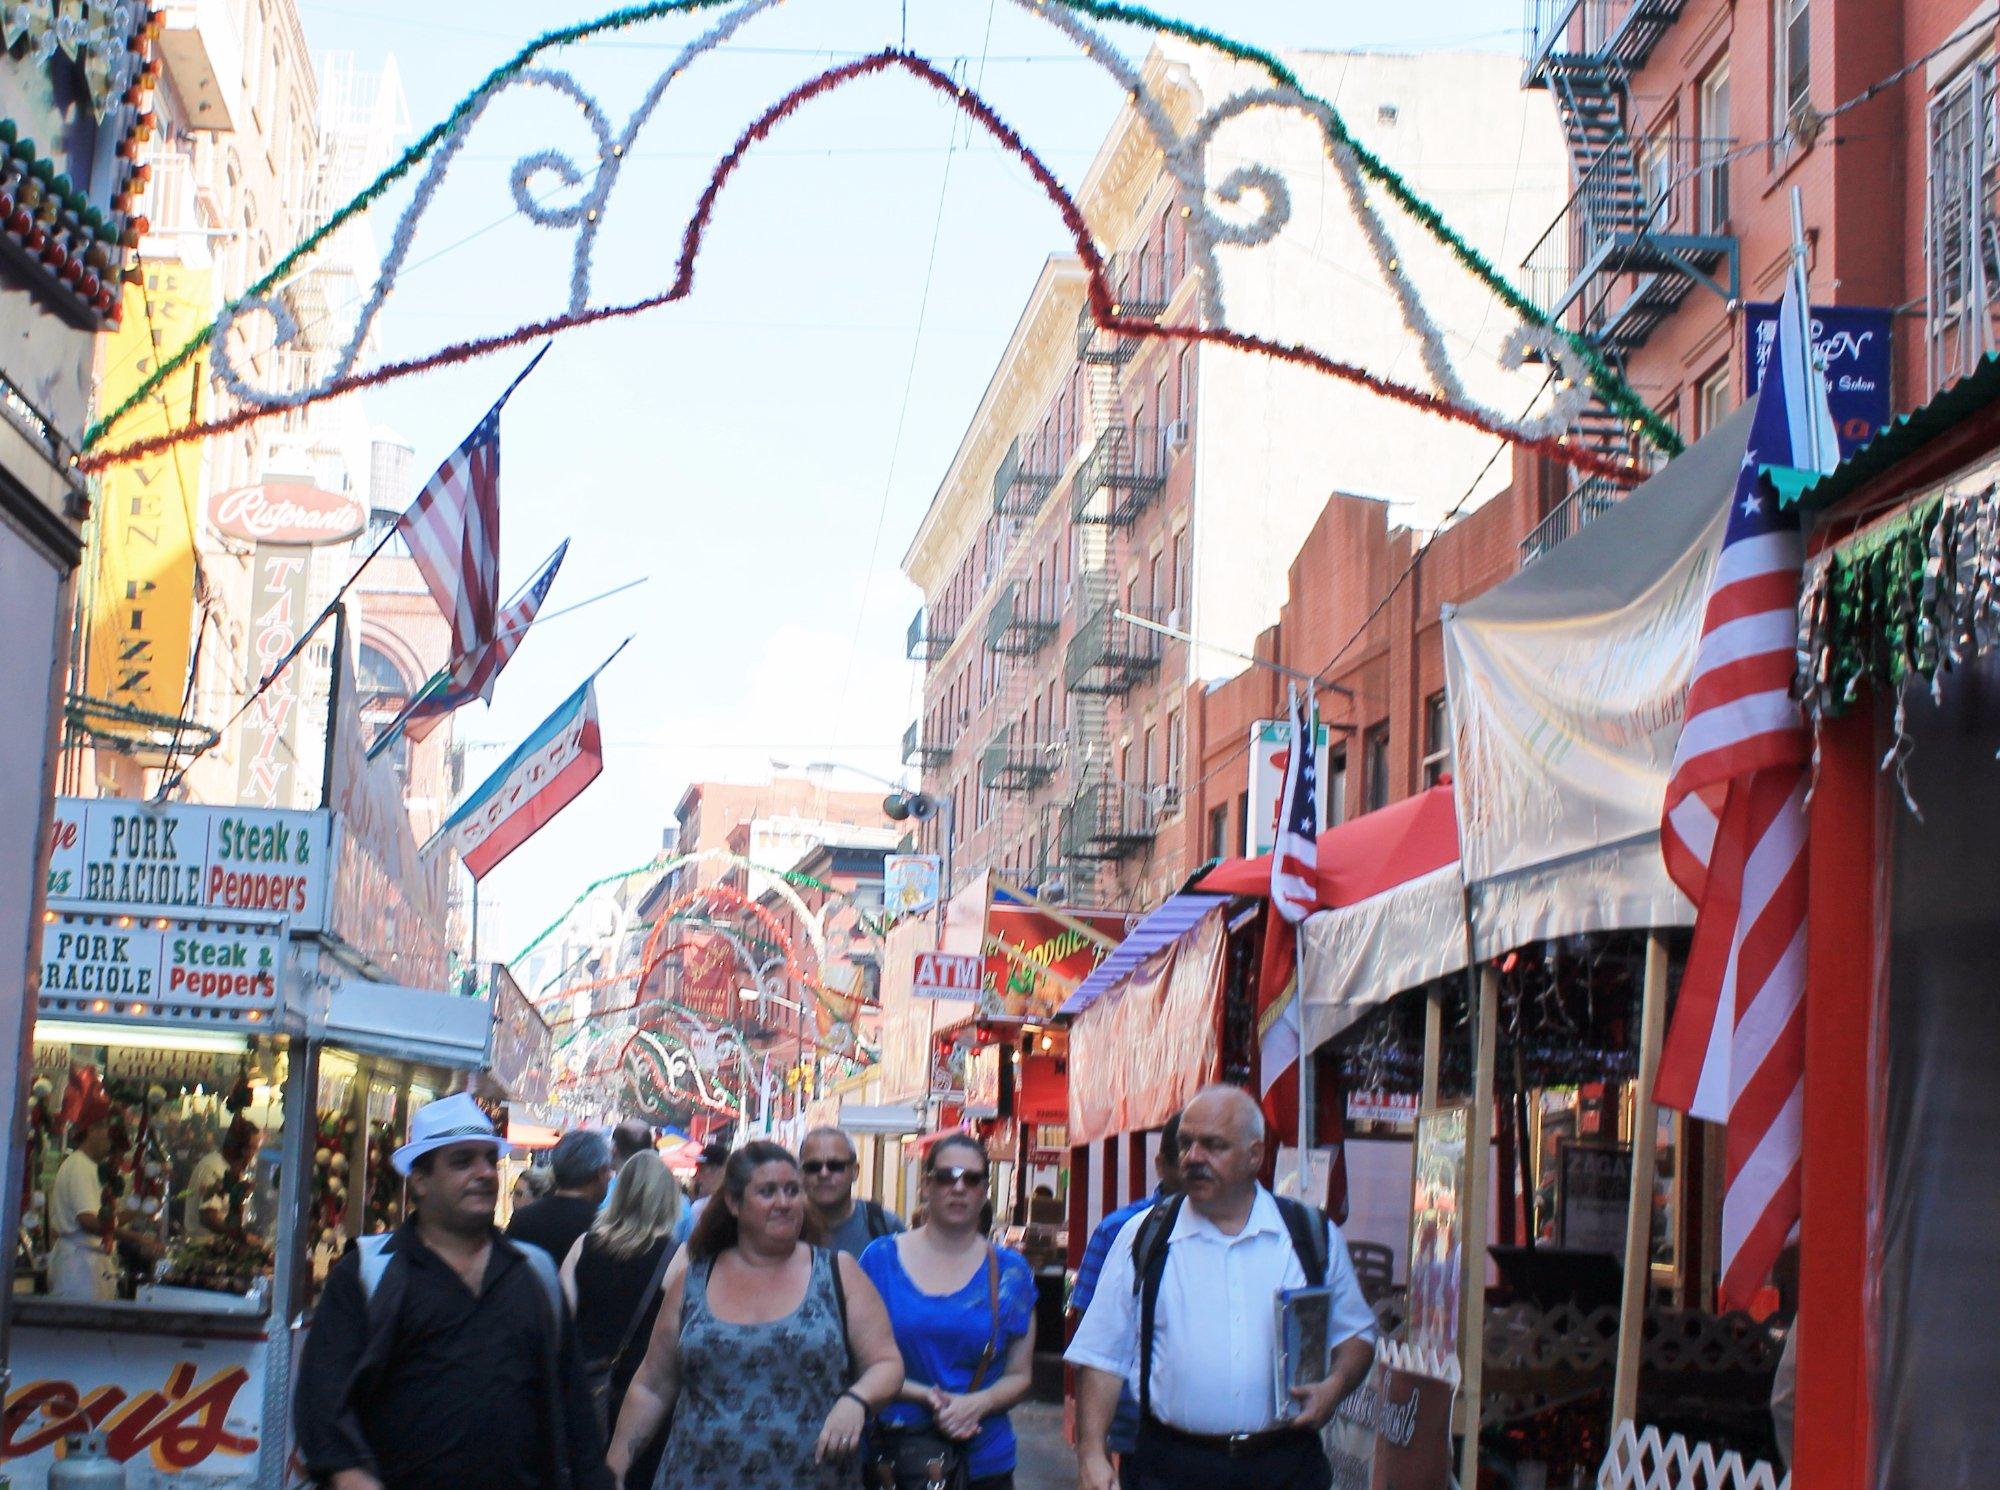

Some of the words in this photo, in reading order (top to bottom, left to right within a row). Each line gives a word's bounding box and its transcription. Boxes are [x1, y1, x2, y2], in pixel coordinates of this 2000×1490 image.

[116, 578, 158, 712] PIZZ
[241, 556, 304, 809] TAORMIN
[110, 813, 179, 861] PORK
[219, 817, 291, 864] Steak
[296, 826, 311, 864] &
[86, 862, 201, 907] BRACIOLE
[209, 863, 307, 912] Peppers
[57, 933, 130, 964] PORK
[172, 936, 248, 968] Steak
[258, 945, 273, 968] &
[917, 954, 979, 989] ATM
[169, 966, 275, 998] Peppers
